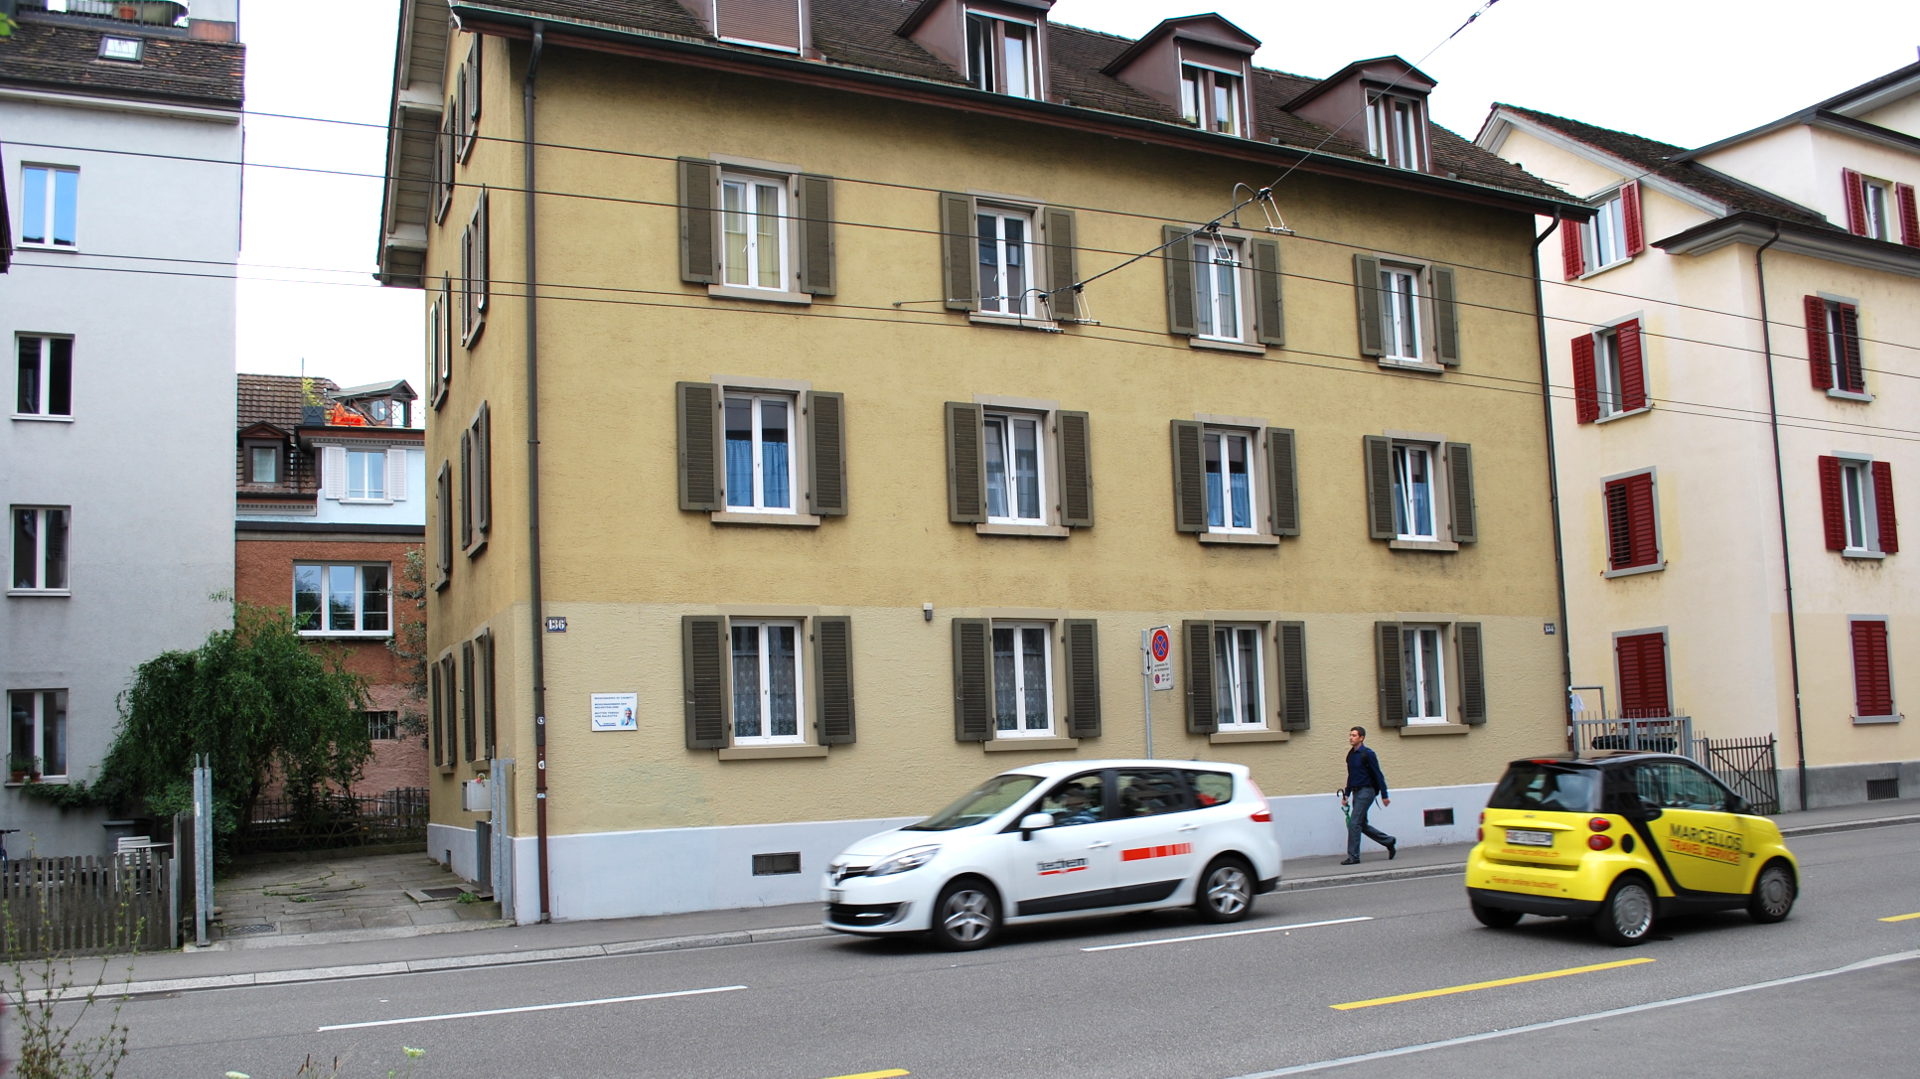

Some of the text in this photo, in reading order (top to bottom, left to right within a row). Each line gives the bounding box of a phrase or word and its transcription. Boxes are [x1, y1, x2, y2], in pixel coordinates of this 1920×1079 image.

[549, 619, 565, 630] 136
[1669, 823, 1742, 851] MARCELLOS
[1669, 838, 1740, 863] TRAVEL SERVICE
